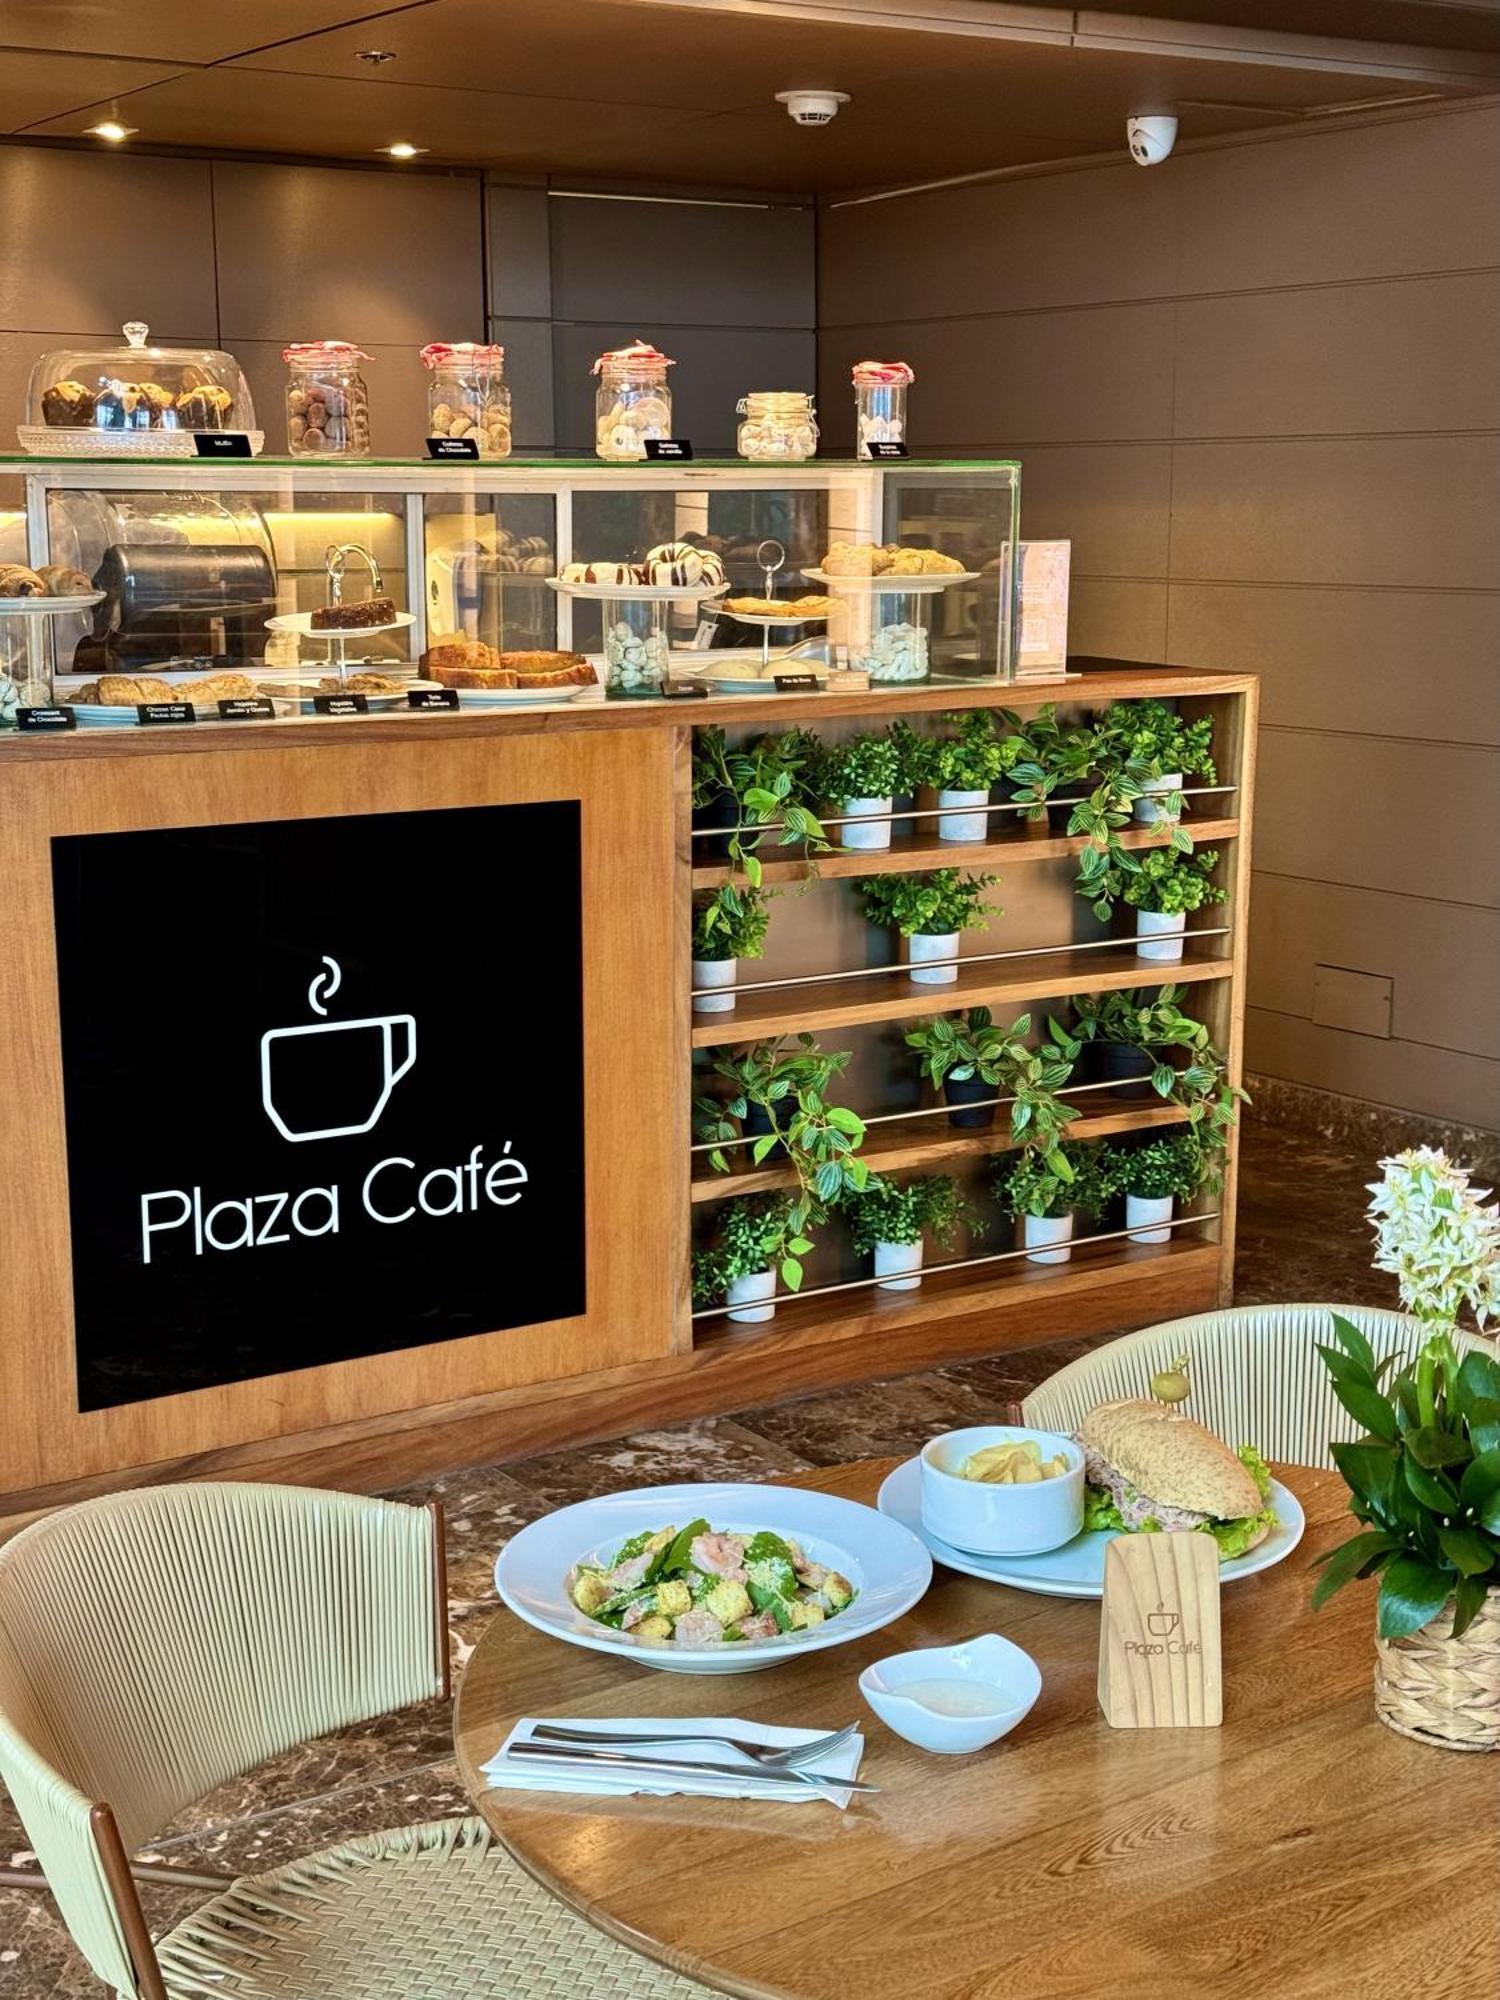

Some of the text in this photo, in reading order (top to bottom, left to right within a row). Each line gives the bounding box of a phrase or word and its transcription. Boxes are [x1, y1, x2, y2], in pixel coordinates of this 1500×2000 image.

[141, 1141, 529, 1264] Plaza Café
[1124, 1640, 1202, 1656] Plaza Café
